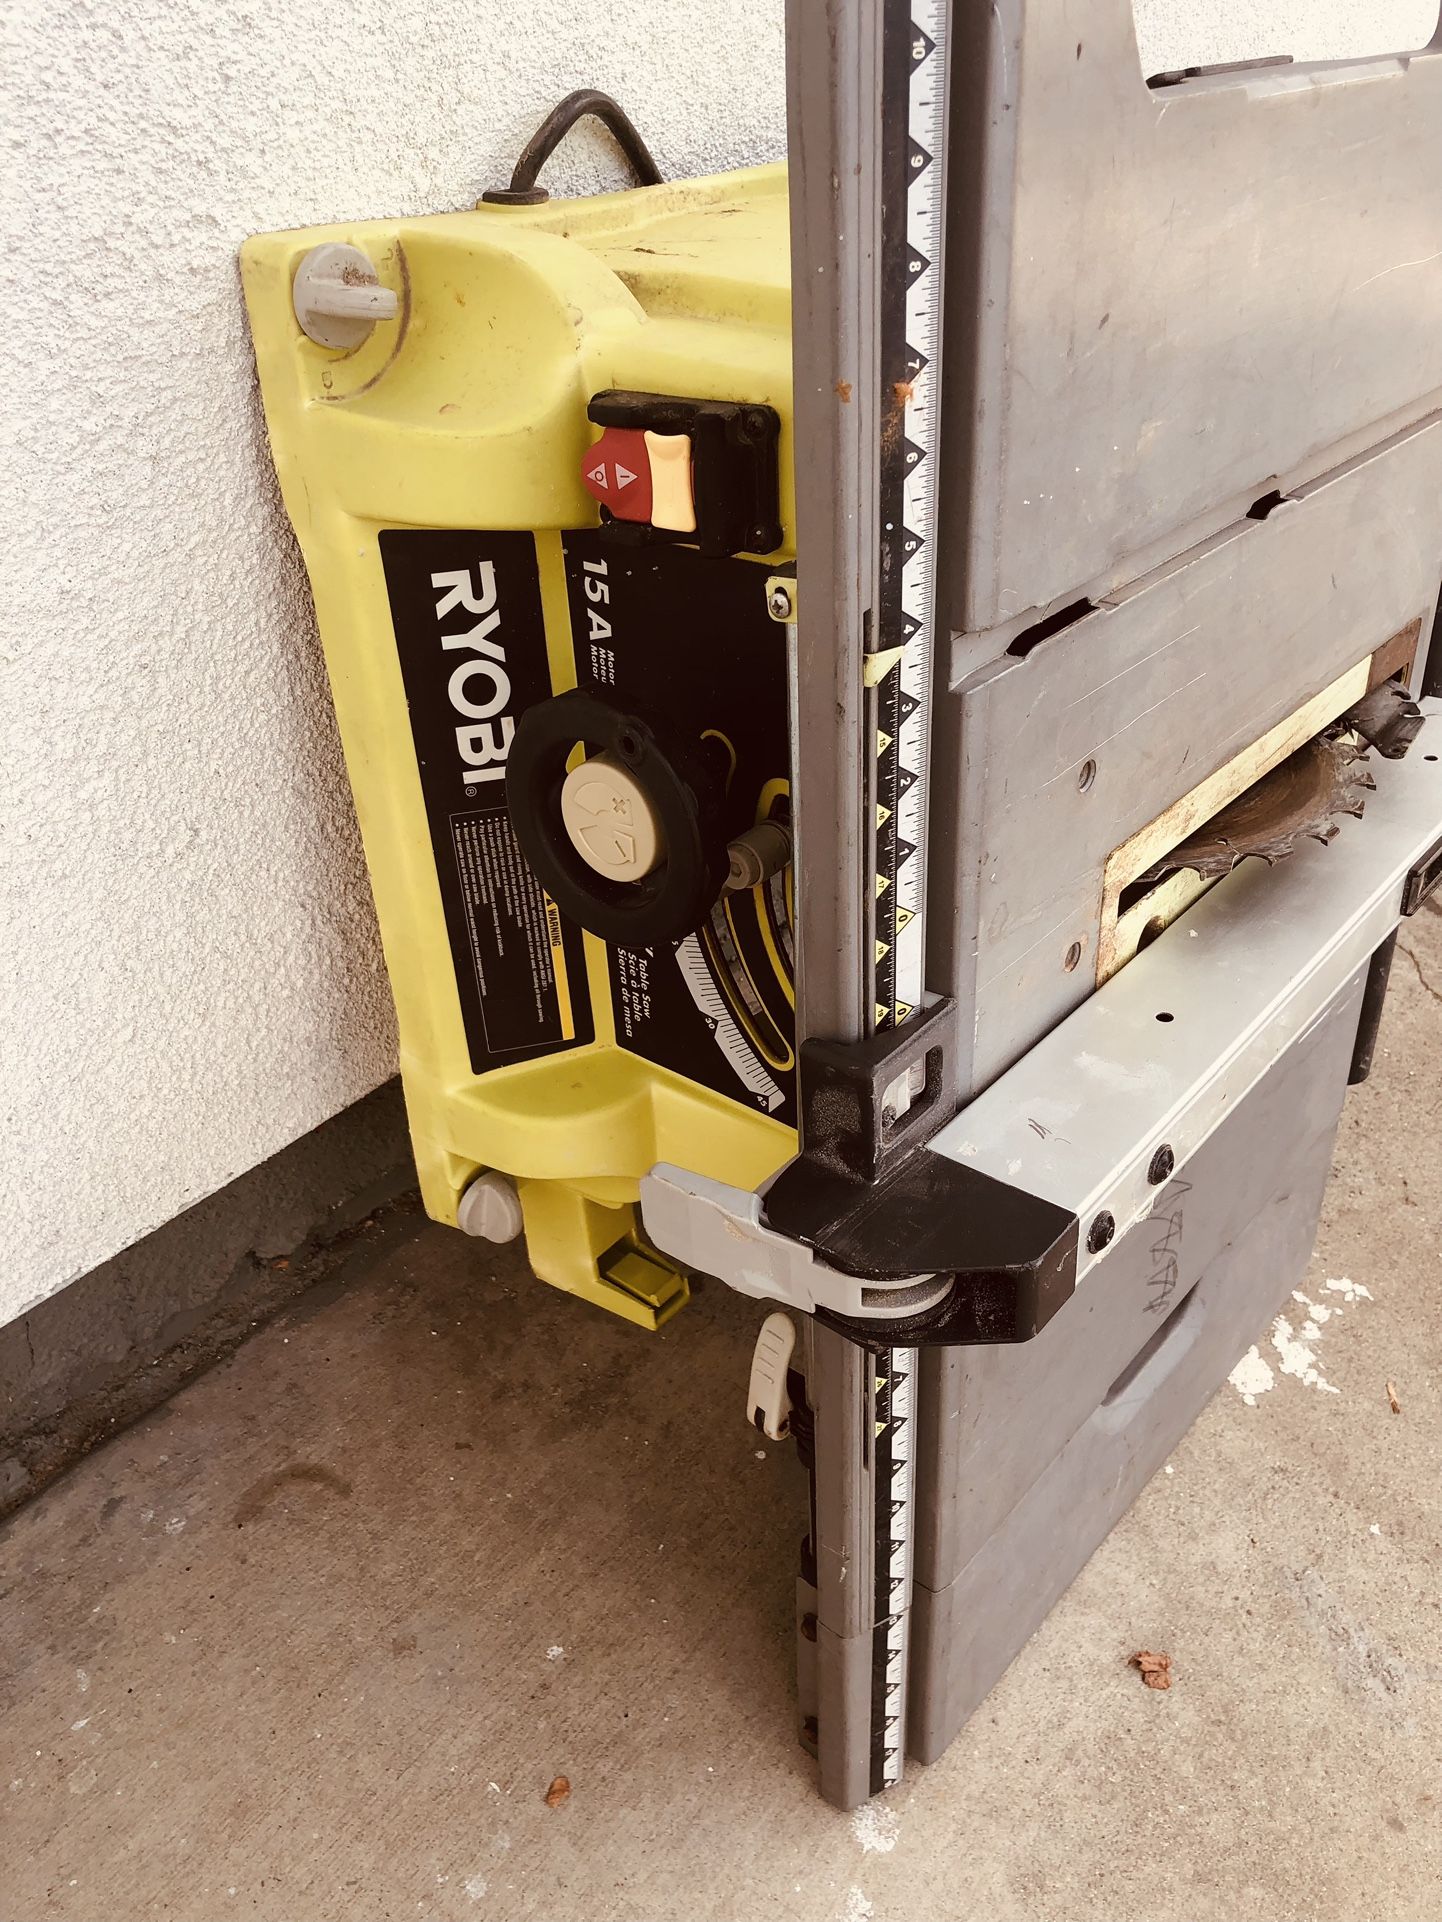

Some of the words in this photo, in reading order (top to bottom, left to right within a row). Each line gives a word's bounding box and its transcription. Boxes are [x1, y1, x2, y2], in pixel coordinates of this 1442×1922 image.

[911, 36, 927, 60] 10
[911, 154, 923, 168] 9
[908, 259, 922, 273] 8
[907, 358, 920, 372] 7
[906, 452, 918, 464] 6
[904, 540, 916, 552] 5
[582, 558, 610, 605] 15
[586, 607, 612, 640] A
[903, 623, 915, 634] 4
[590, 644, 598, 680] Motor
[598, 647, 607, 684] Moteu
[607, 650, 616, 686] Motor
[431, 561, 514, 783] RYOBI
[901, 702, 913, 713] 3
[878, 737, 886, 748] 15
[900, 777, 912, 787] 2
[878, 810, 886, 822] 16
[898, 848, 910, 857] 1
[878, 880, 885, 890] 17
[897, 913, 909, 924] 0
[546, 908, 562, 948] WARNING
[877, 945, 884, 956] 18
[616, 948, 628, 984] Sierra
[627, 952, 638, 977] Scie
[638, 958, 651, 990] Table
[621, 987, 632, 1003] de
[631, 991, 642, 1022] table
[641, 993, 652, 1019] Saw
[876, 1008, 884, 1018] 19
[896, 1008, 908, 1018] 0
[623, 1005, 634, 1038] mesa
[704, 1017, 716, 1030] 30
[756, 1095, 767, 1108] 45
